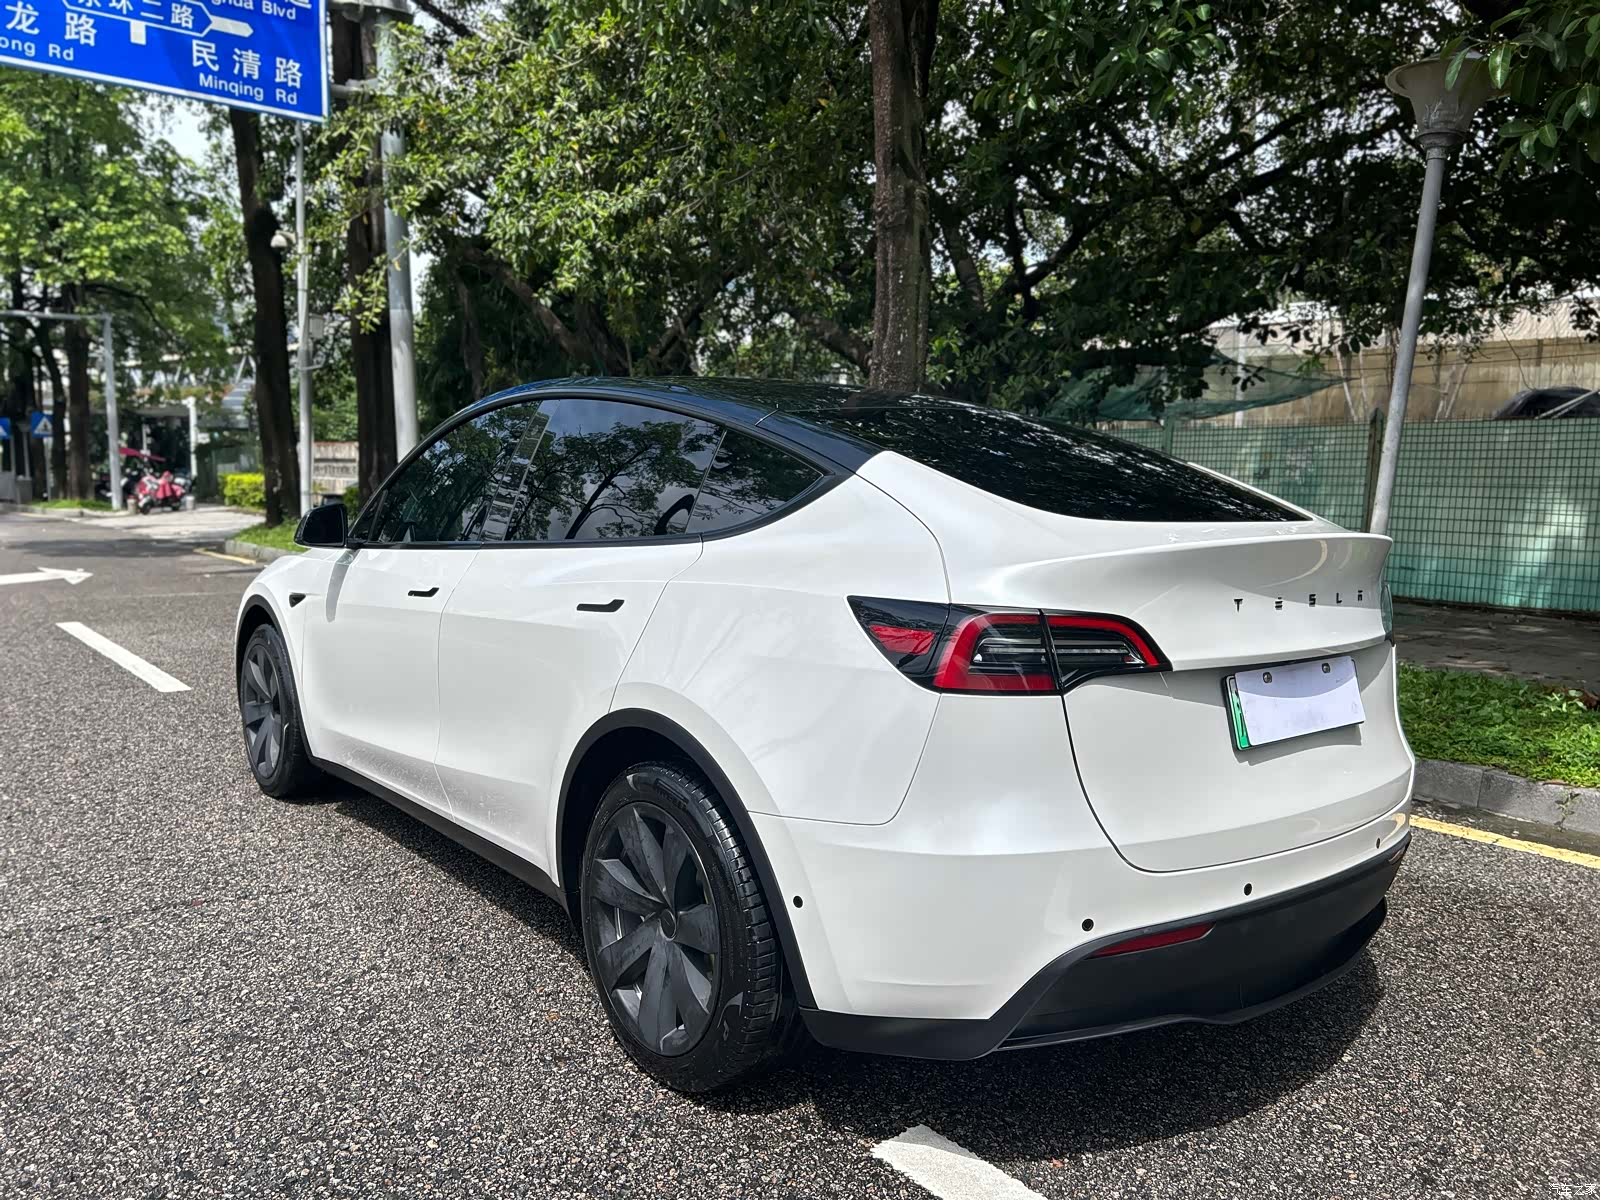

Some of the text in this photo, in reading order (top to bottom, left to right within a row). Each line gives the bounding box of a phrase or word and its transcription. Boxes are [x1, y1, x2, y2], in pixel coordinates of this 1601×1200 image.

[262, 0, 296, 20] Blvd
[48, 43, 74, 61] Rd
[192, 39, 303, 89] 民清路
[199, 72, 298, 105] Minqing Rd
[1234, 590, 1363, 612] TESLA
